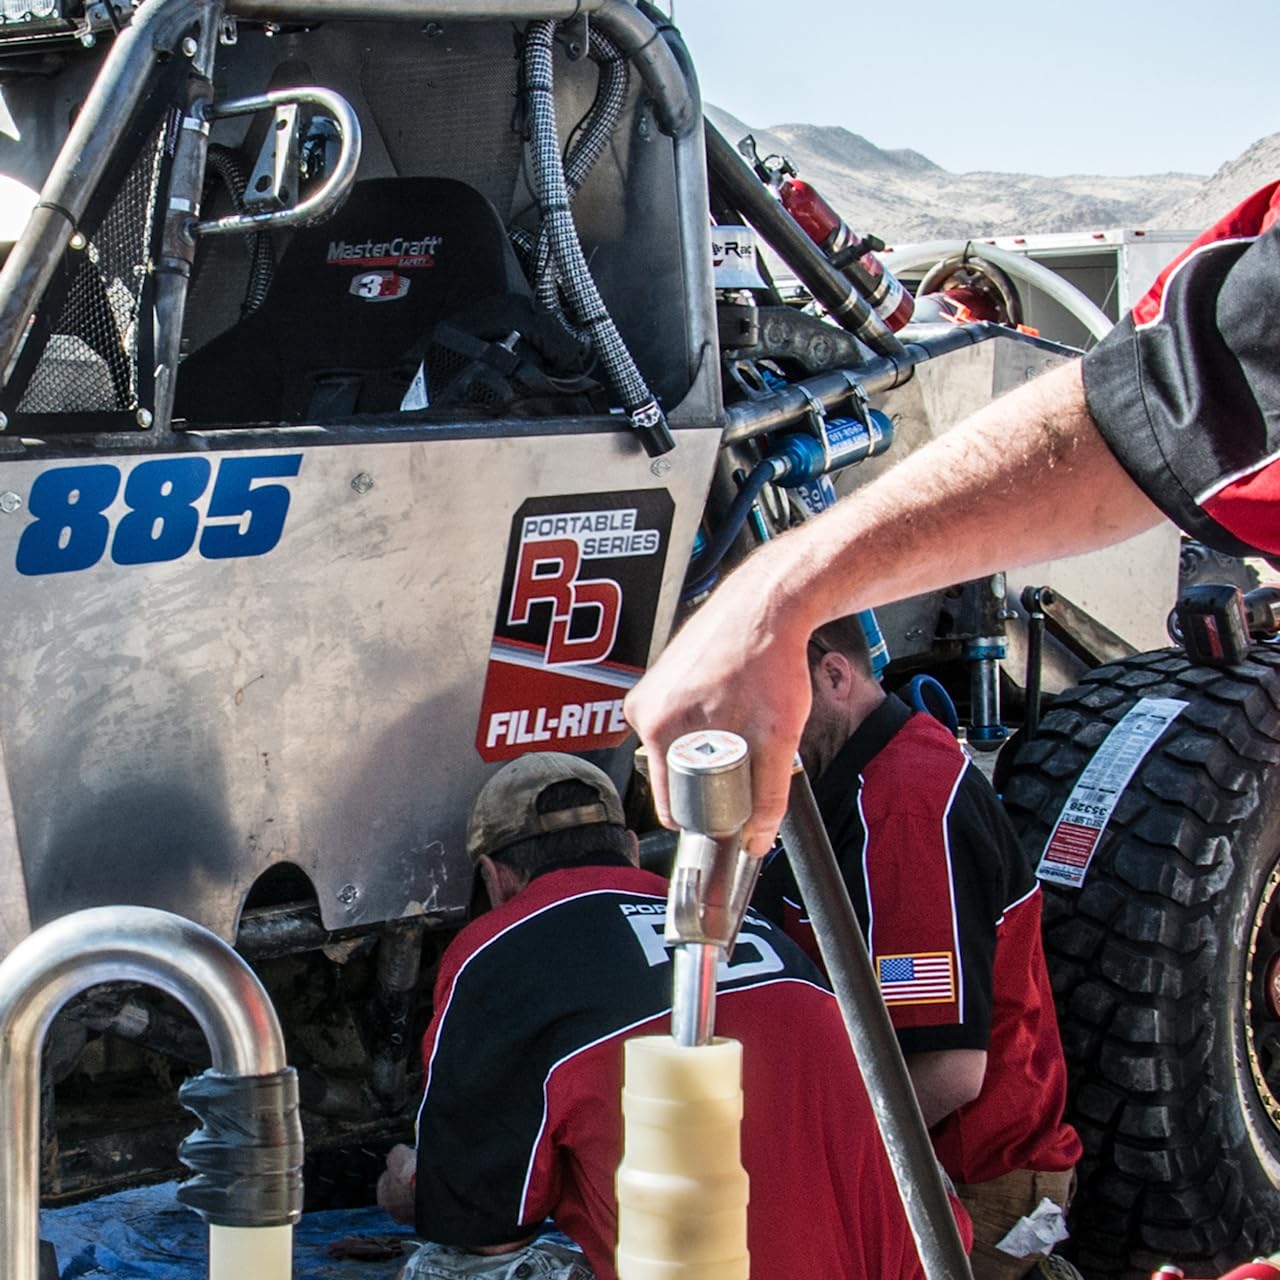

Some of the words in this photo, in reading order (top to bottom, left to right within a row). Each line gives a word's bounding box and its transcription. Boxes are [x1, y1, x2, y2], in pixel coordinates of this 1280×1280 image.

[327, 237, 438, 261] MasterCraft
[15, 453, 304, 576] 885
[524, 512, 635, 538] PORTABLE
[583, 532, 659, 556] SERIES
[507, 538, 622, 667] RD
[486, 699, 631, 749] FILL-RITE
